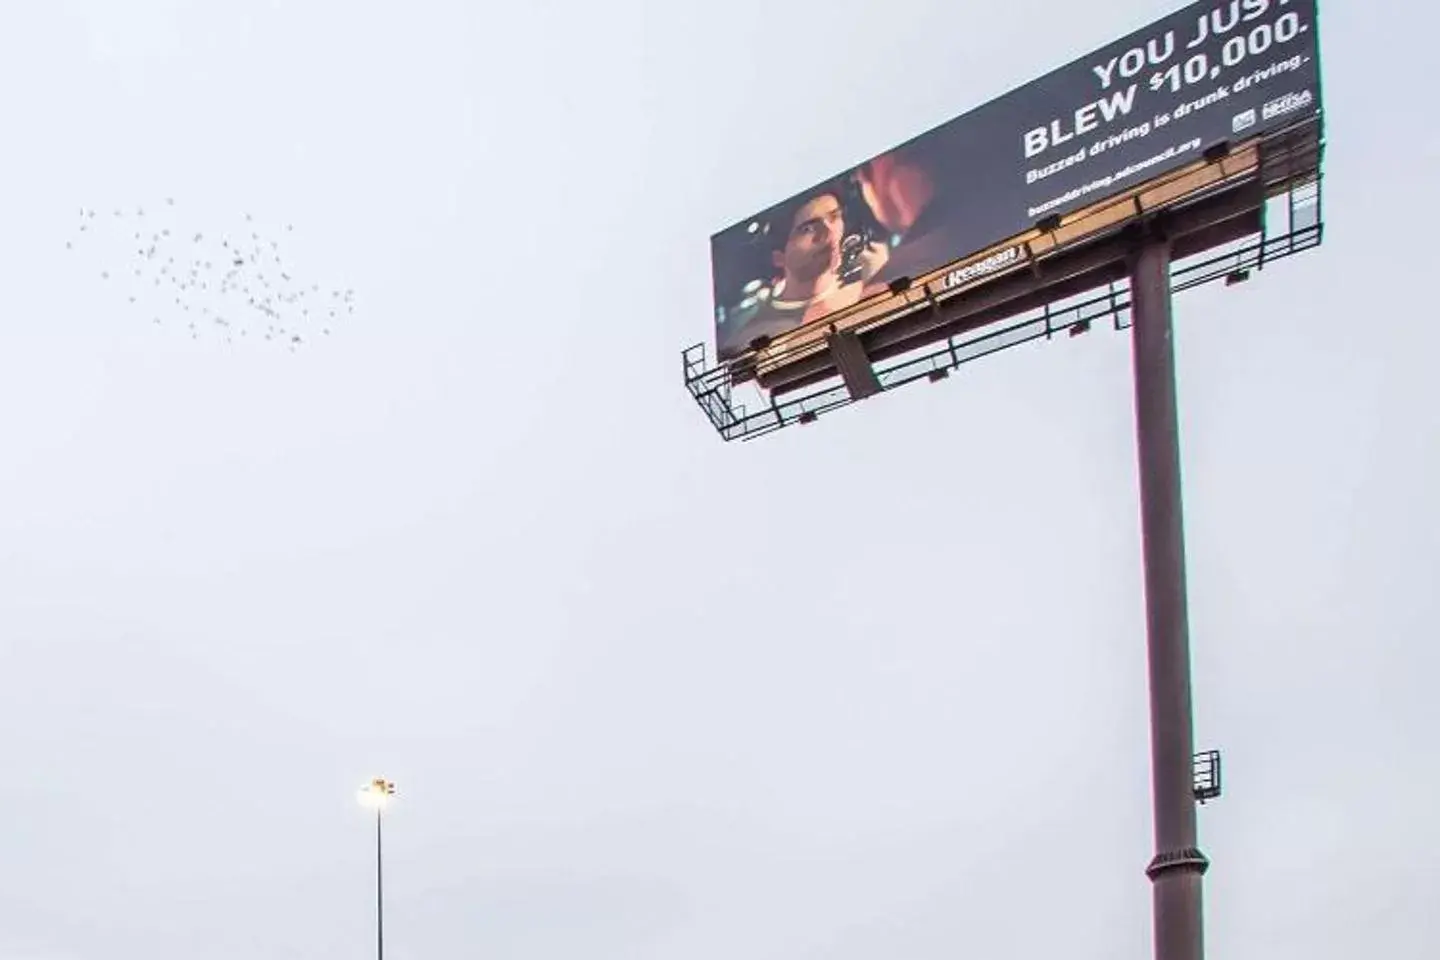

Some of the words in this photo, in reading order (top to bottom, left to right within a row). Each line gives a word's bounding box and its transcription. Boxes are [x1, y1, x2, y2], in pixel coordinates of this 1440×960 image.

[1023, 84, 1140, 158] BLEW
[1150, 12, 1309, 93] $10,000.
[1093, 30, 1175, 89] YOU
[1186, 0, 1290, 49] JUS
[1026, 148, 1086, 184] Buzzed
[1090, 120, 1150, 157] driving
[1154, 112, 1169, 129] is
[1174, 86, 1229, 119] drunk
[1233, 55, 1310, 94] driving.
